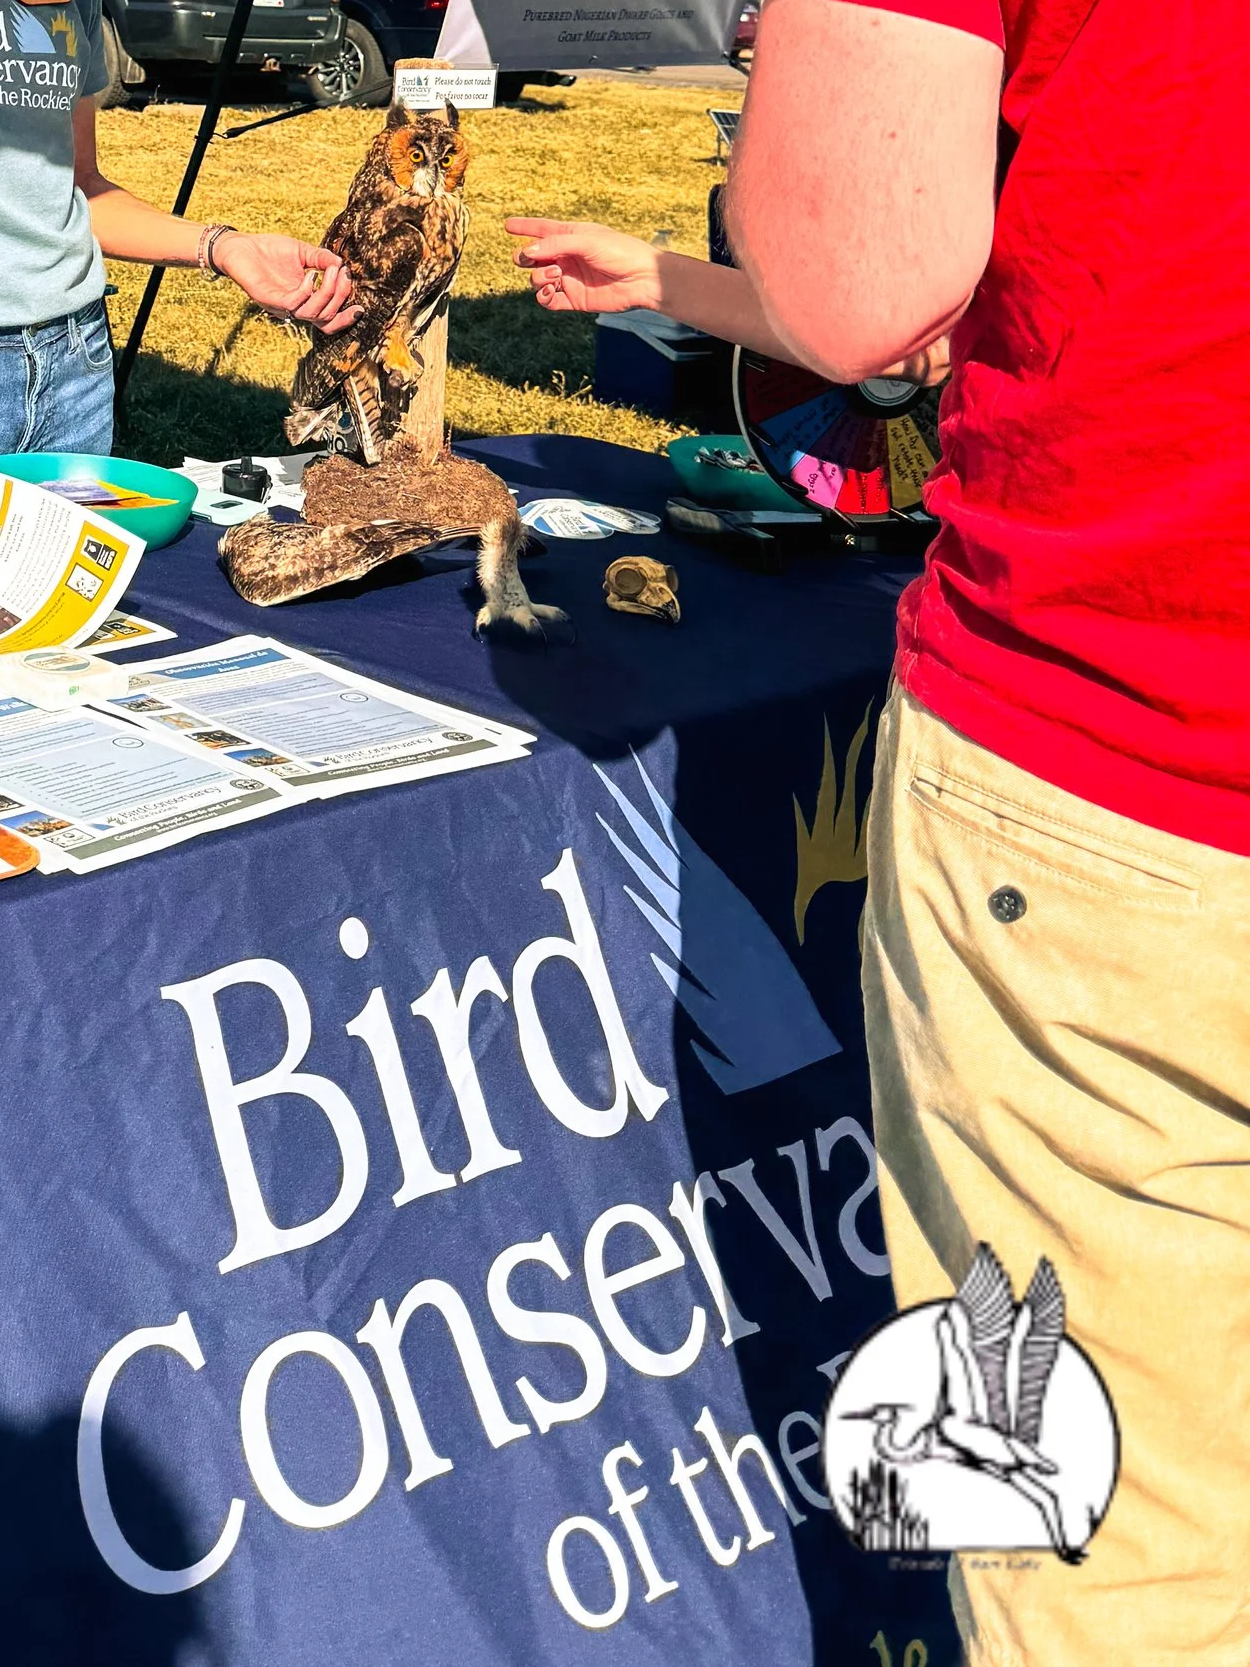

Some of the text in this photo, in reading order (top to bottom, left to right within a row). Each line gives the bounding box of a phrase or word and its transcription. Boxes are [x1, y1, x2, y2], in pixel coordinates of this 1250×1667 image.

[402, 77, 416, 86] Bird
[434, 77, 492, 86] Please do not touch
[435, 92, 447, 100] Por
[447, 91, 464, 101] favor
[160, 847, 670, 1278] Bird
[76, 1114, 896, 1596] Conserva
[546, 1405, 834, 1631] of the
